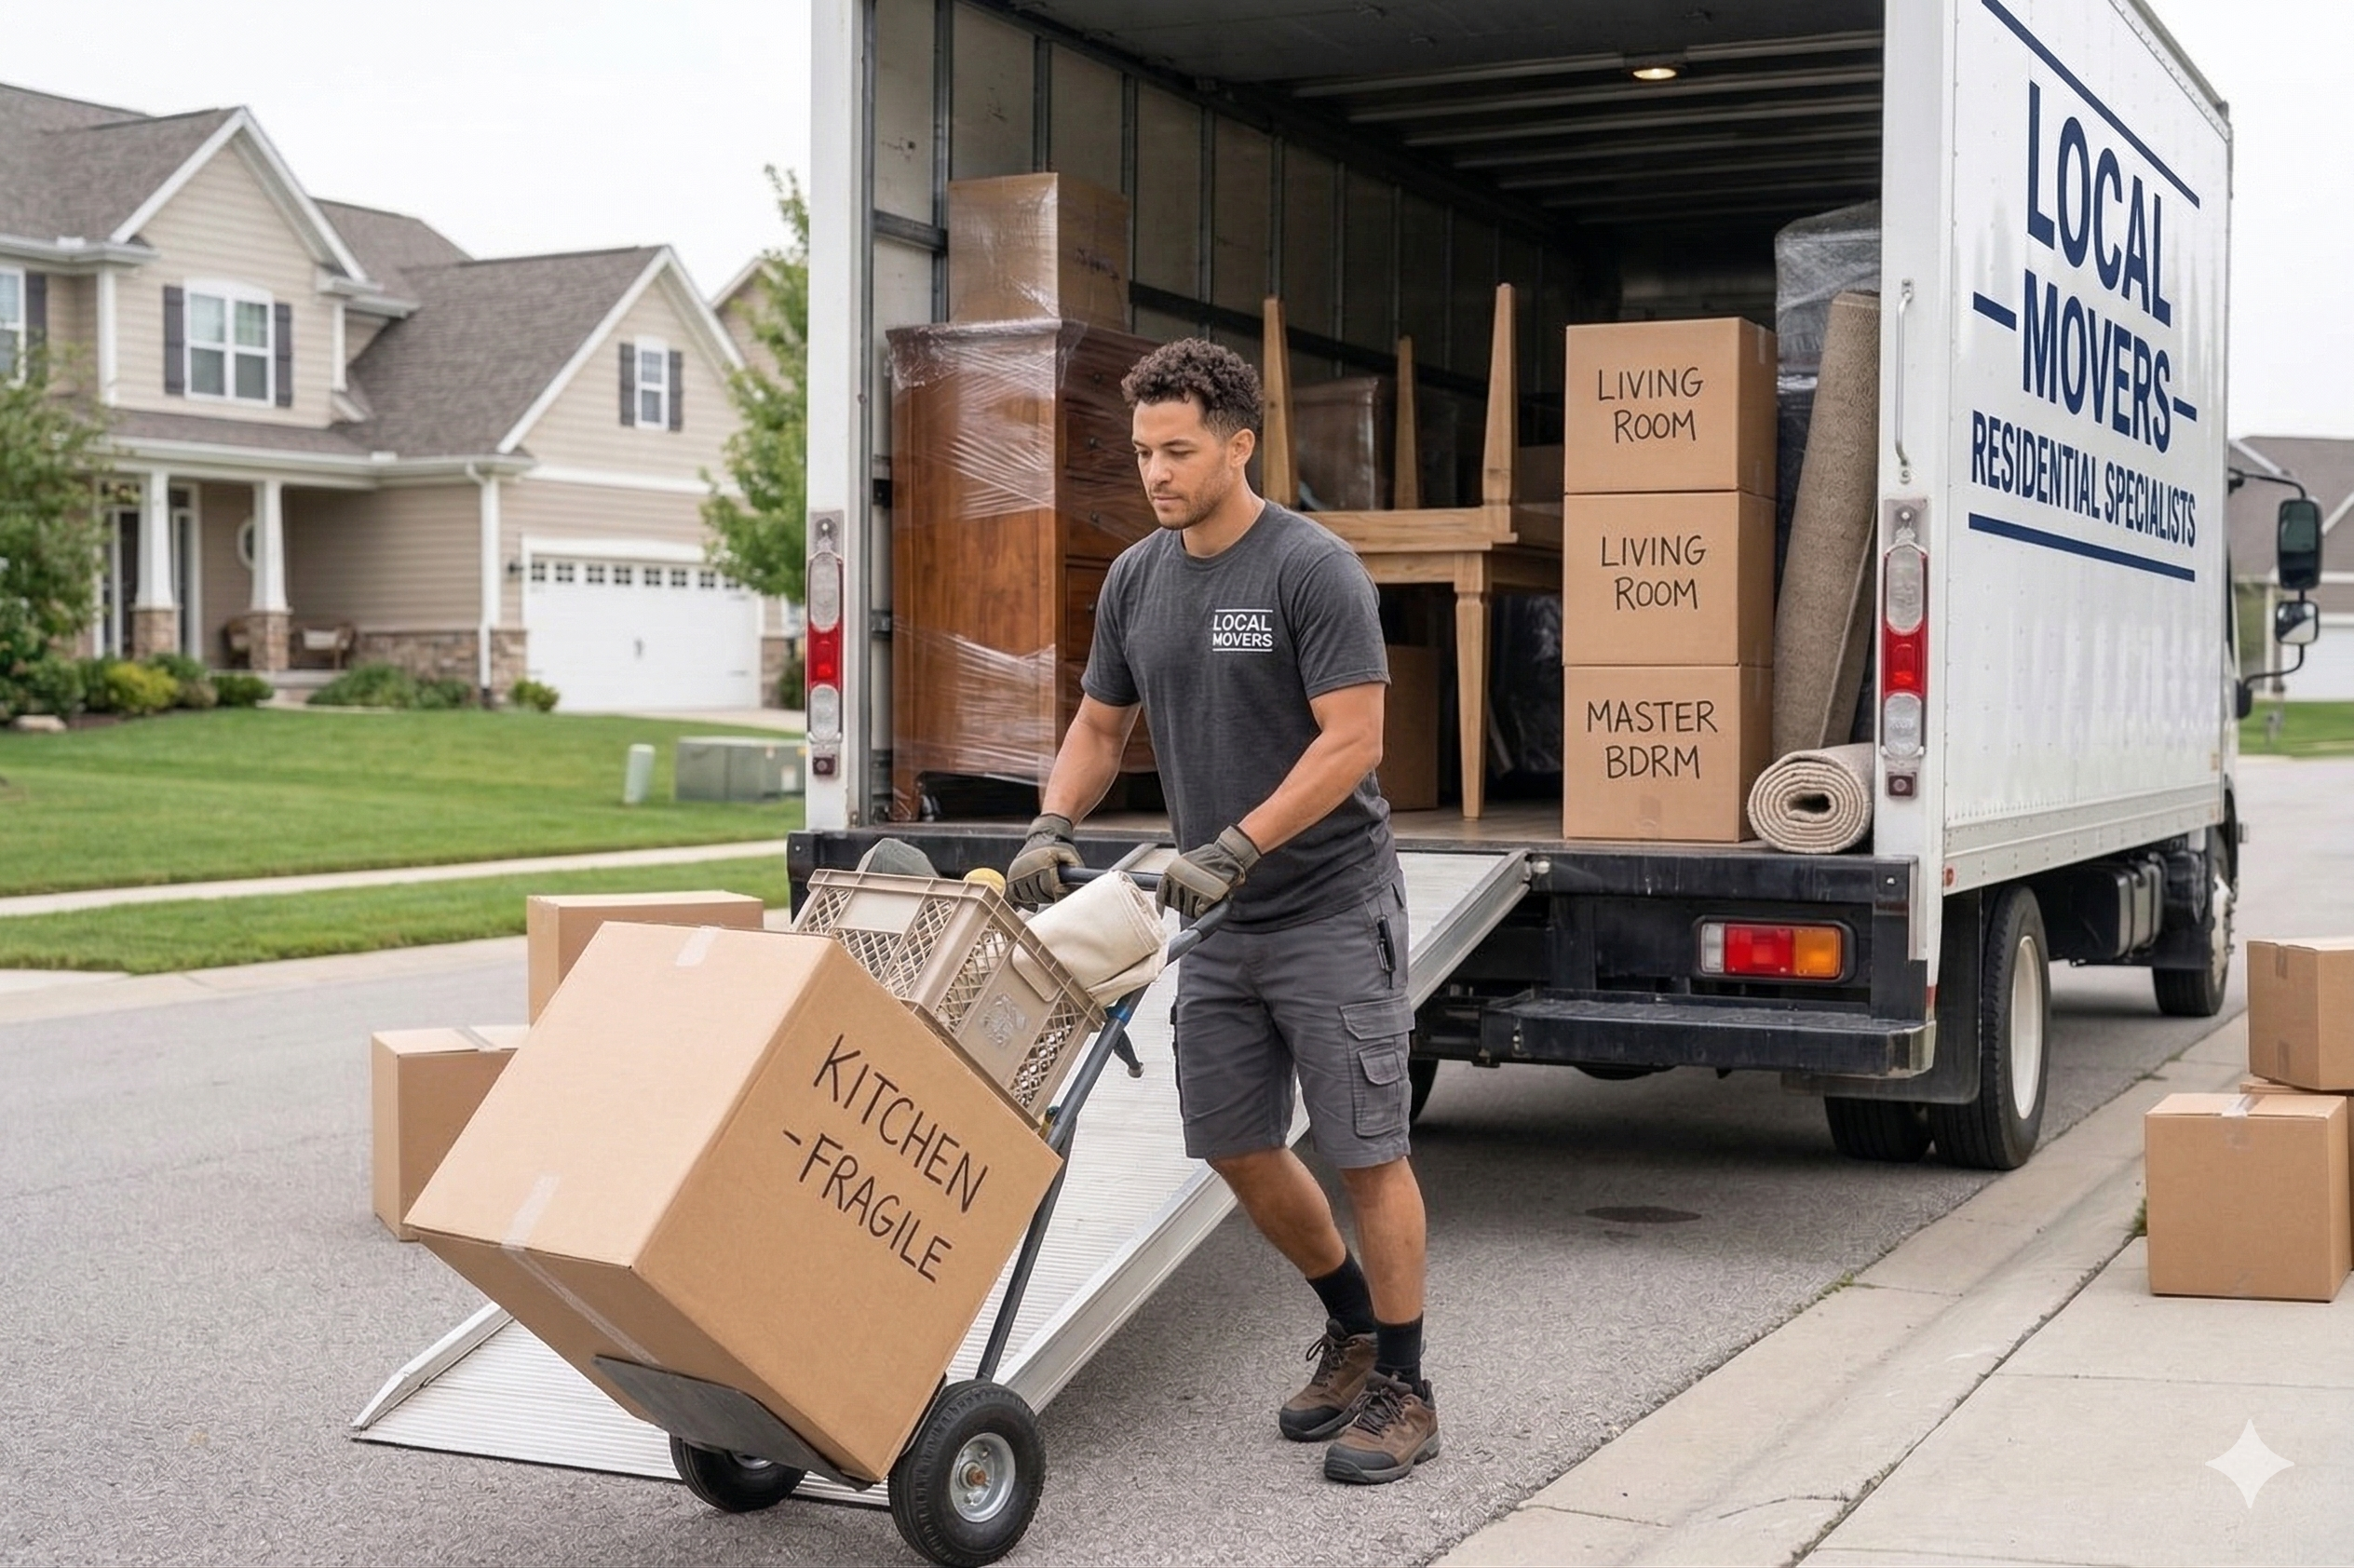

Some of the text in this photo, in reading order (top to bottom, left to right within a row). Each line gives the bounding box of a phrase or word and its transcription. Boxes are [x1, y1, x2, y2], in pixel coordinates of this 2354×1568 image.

[2027, 80, 2171, 328] LOCAL
[1598, 367, 1704, 400] LIVING
[1614, 410, 1697, 443] ROOM
[1971, 410, 2196, 548] RESIDENTIAL SPECIALISTS
[1601, 534, 1707, 567] LIVING
[1615, 576, 1698, 610] ROOM
[1212, 614, 1272, 631] LOCAL
[1212, 632, 1273, 647] MOVERS
[1587, 699, 1719, 734] MASTER
[1605, 744, 1701, 779] BDRM
[813, 1034, 989, 1213] KITCHEN
